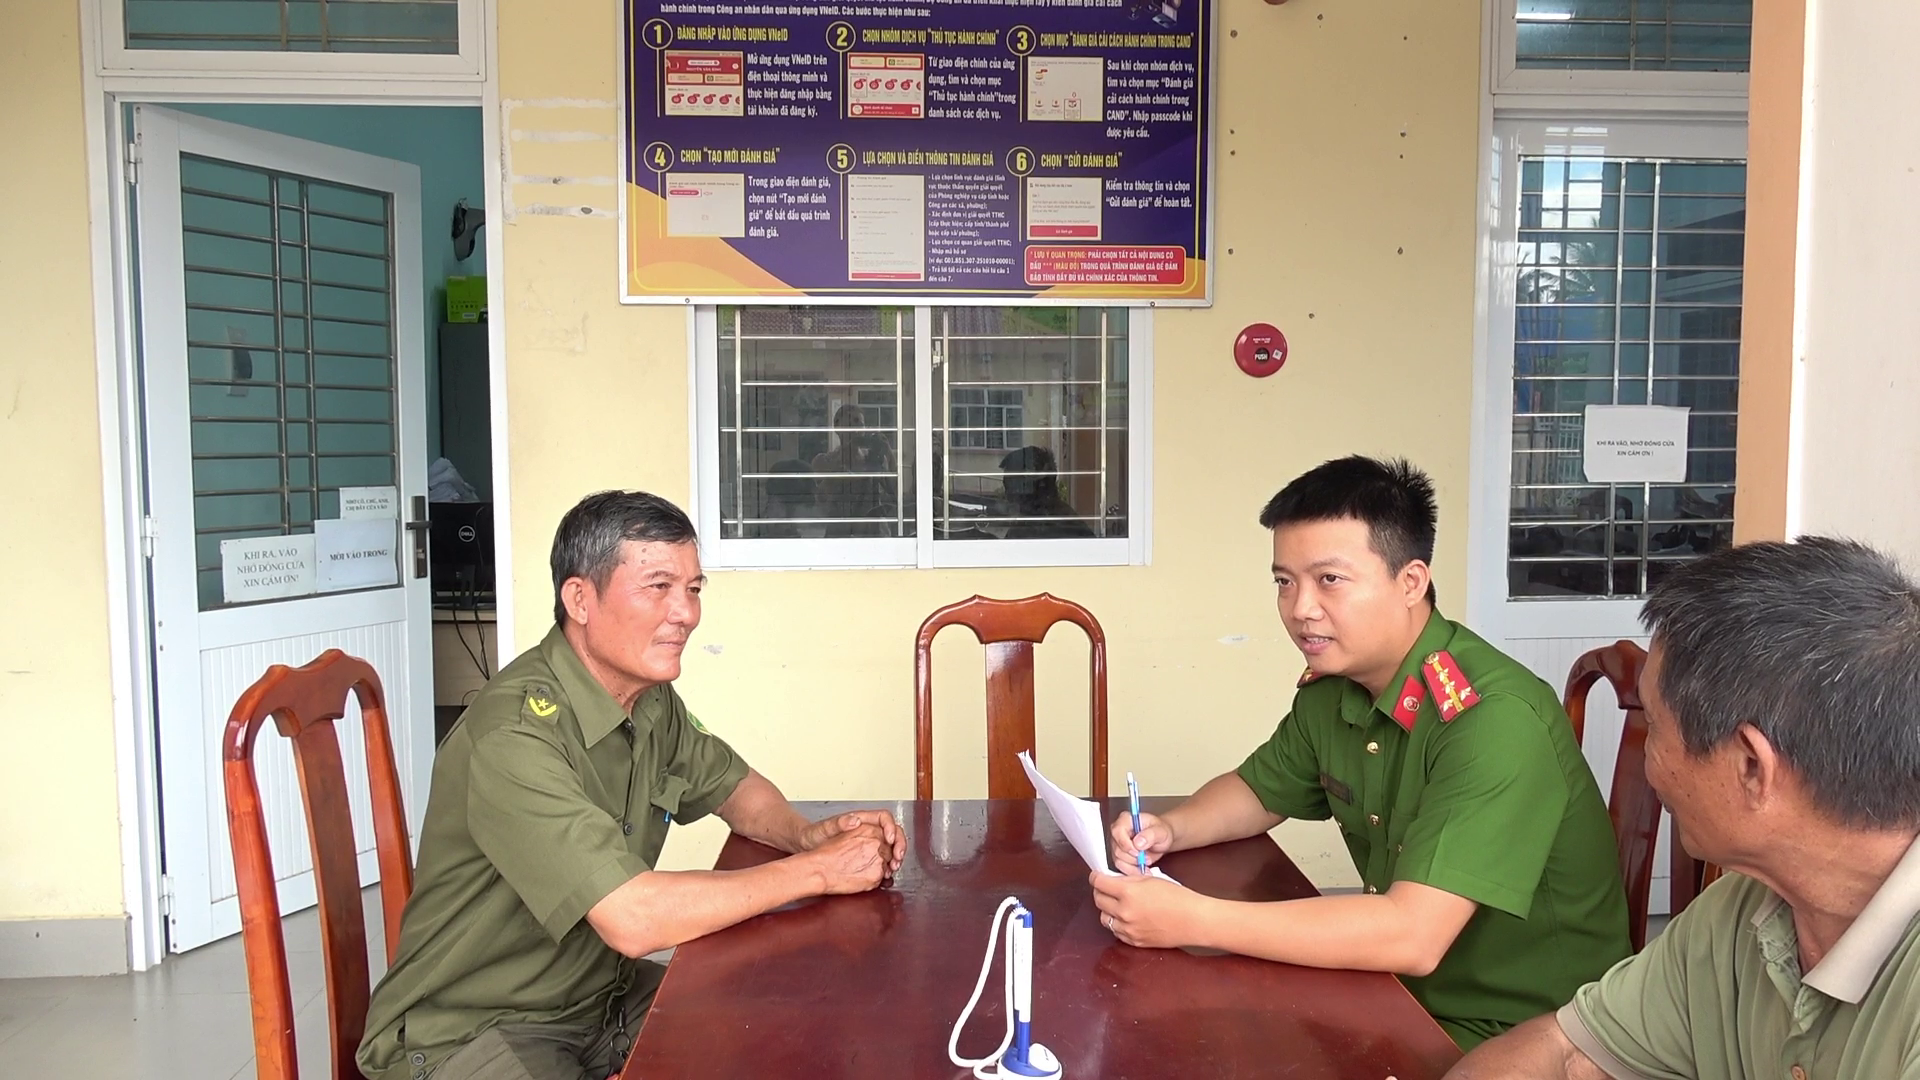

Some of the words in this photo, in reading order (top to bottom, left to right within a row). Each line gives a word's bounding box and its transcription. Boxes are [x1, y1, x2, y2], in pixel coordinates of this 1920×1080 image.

[654, 25, 661, 43] 1
[678, 25, 696, 41] ĐĂNG
[698, 25, 715, 43] NHẬP
[718, 25, 731, 41] VÀO
[733, 26, 746, 41] ỨNG
[748, 28, 766, 44] DỤNG
[768, 28, 788, 42] VNeID
[837, 27, 847, 46] 2
[863, 29, 879, 45] CHỌN
[881, 28, 900, 43] NHÓM
[902, 30, 917, 46] DỊCH
[919, 30, 926, 47] VỤ
[945, 31, 957, 47] TỤC
[958, 30, 975, 45] HÀNH
[1017, 31, 1028, 50] 3
[748, 53, 758, 65] Mở
[760, 54, 772, 67] ứng
[774, 54, 789, 68] dụng
[792, 54, 811, 65] VNeID
[813, 55, 827, 66] trên
[929, 56, 937, 68] Từ
[939, 57, 952, 70] giao
[955, 57, 968, 70] diện
[970, 58, 987, 69] chính
[989, 57, 1001, 69] của
[1003, 59, 1015, 71] ứng
[1107, 60, 1119, 71] Sau
[1121, 60, 1131, 71] khi
[1133, 60, 1148, 73] chọn
[1150, 60, 1168, 72] nhóm
[1170, 61, 1183, 74] dịch
[1185, 63, 1194, 74] vụ,
[748, 71, 761, 84] điện
[763, 71, 780, 84] thoại
[782, 71, 800, 84] thông
[803, 71, 818, 82] minh
[820, 72, 827, 83] và
[929, 73, 946, 87] dụng,
[948, 74, 959, 85] tìm
[961, 75, 969, 85] và
[971, 75, 986, 88] chọn
[988, 77, 1001, 88] mục
[1107, 77, 1118, 88] tìm
[1120, 77, 1127, 88] và
[1129, 77, 1144, 90] chọn
[1146, 80, 1159, 90] mục
[1161, 77, 1181, 88] “Đánh
[1183, 77, 1193, 90] giá
[748, 88, 762, 101] thực
[764, 88, 778, 101] hiện
[780, 88, 796, 101] đăng
[798, 88, 813, 102] nhập
[816, 87, 831, 102] bằng
[929, 89, 945, 102] “Thủ
[947, 91, 957, 104] tục
[959, 91, 975, 102] hành
[1118, 94, 1133, 105] cách
[1135, 94, 1151, 105] hành
[1152, 94, 1169, 105] chính
[1172, 95, 1189, 107] trong
[748, 105, 757, 116] tài
[759, 104, 778, 116] khoản
[780, 105, 788, 116] đã
[790, 105, 806, 118] đăng
[808, 105, 817, 118] ký.
[929, 107, 944, 118] danh
[946, 108, 961, 119] sách
[963, 108, 974, 119] các
[976, 108, 989, 121] dịch
[991, 111, 1001, 122] vụ.
[1133, 110, 1149, 123] Nhập
[1151, 111, 1180, 123] passcode
[1182, 111, 1192, 122] khi
[1107, 127, 1121, 140] được
[1123, 127, 1135, 140] yêu
[655, 148, 666, 166] 4
[681, 150, 701, 166] CHỌN
[724, 148, 739, 164] MỚI
[741, 148, 761, 164] ĐÁNH
[837, 150, 847, 168] 5
[863, 151, 876, 168] LỰA
[878, 152, 895, 168] CHỌN
[897, 150, 906, 165] VÀ
[925, 150, 947, 166] THÔNG
[950, 153, 960, 166] TIN
[962, 151, 981, 166] ĐÁNH
[983, 151, 993, 167] GIÁ
[1016, 152, 1027, 171] 6
[1041, 154, 1061, 170] CHỌN
[1083, 153, 1103, 168] ĐÁNH
[749, 176, 768, 189] Trong
[770, 176, 783, 189] giao
[786, 176, 799, 190] diện
[801, 176, 816, 187] đánh
[819, 176, 831, 189] giá,
[1106, 178, 1122, 191] Kiểm
[1124, 181, 1133, 191] tra
[1135, 180, 1153, 193] thông
[1155, 181, 1163, 191] tin
[1165, 181, 1172, 192] và
[1174, 181, 1190, 194] chọn
[749, 193, 764, 206] chọn
[766, 193, 777, 204] nút
[779, 193, 795, 206] “Tạo
[797, 193, 809, 204] mới
[811, 193, 826, 204] đánh
[1122, 197, 1136, 208] đánh
[1138, 197, 1152, 210] giá”
[1164, 197, 1179, 208] hoàn
[1181, 196, 1192, 208] tất.
[749, 210, 763, 222] giá”
[801, 210, 812, 223] quá
[814, 210, 830, 221] trình
[749, 227, 765, 237] đánh
[767, 227, 778, 239] giá.
[244, 552, 260, 560] KHI
[278, 548, 297, 558] VÀO
[346, 550, 361, 559] VÀO
[363, 550, 387, 558] TRONG
[259, 562, 284, 573] ĐÓNG
[244, 579, 259, 587] XIN
